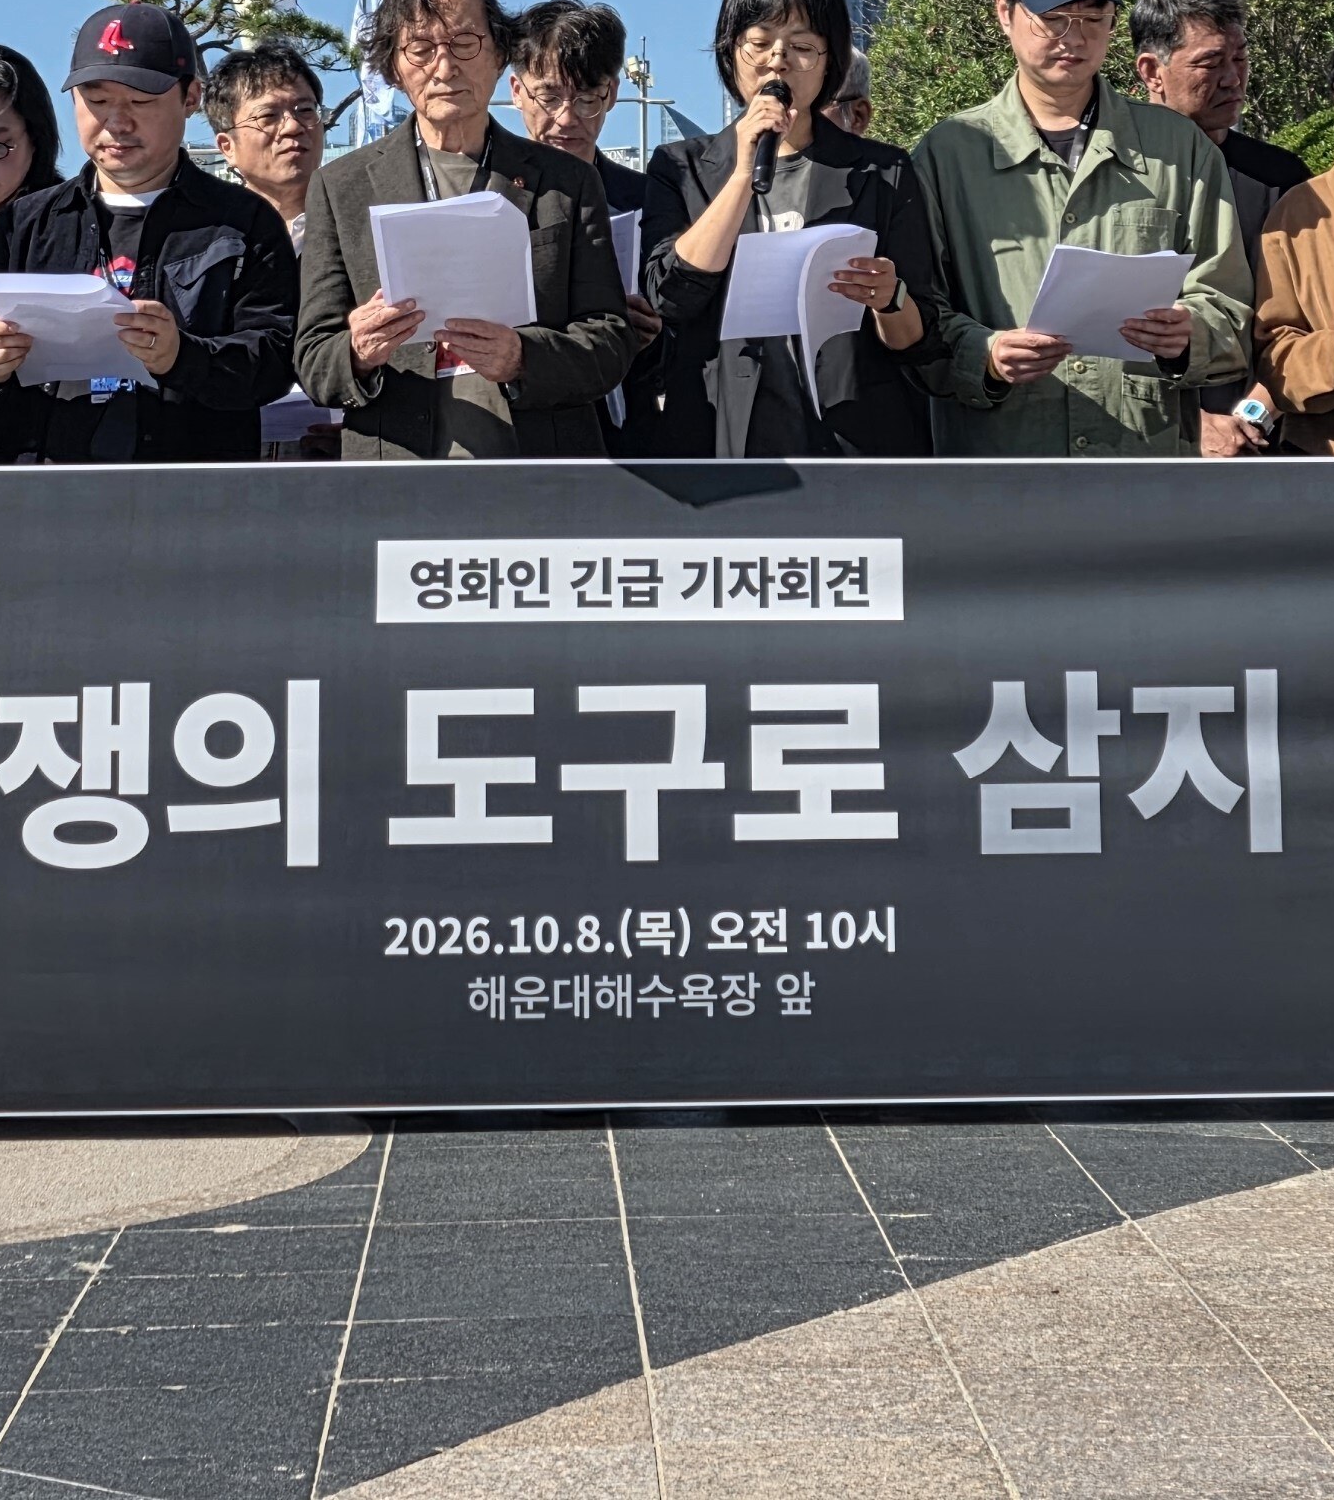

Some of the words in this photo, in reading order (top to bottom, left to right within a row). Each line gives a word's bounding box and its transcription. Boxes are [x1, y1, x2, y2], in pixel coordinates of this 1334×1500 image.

[410, 557, 551, 610] 영화인
[570, 556, 664, 609] 긴급
[680, 556, 870, 609] 기자회견
[388, 683, 899, 862] 도구로
[952, 668, 1283, 854] 삼지
[384, 907, 692, 958] 2026.10.8.(목)
[707, 908, 788, 954] 오전
[806, 906, 897, 954] 10시
[467, 971, 762, 1021] 해운대해수욕장
[776, 971, 816, 1017] 앞
